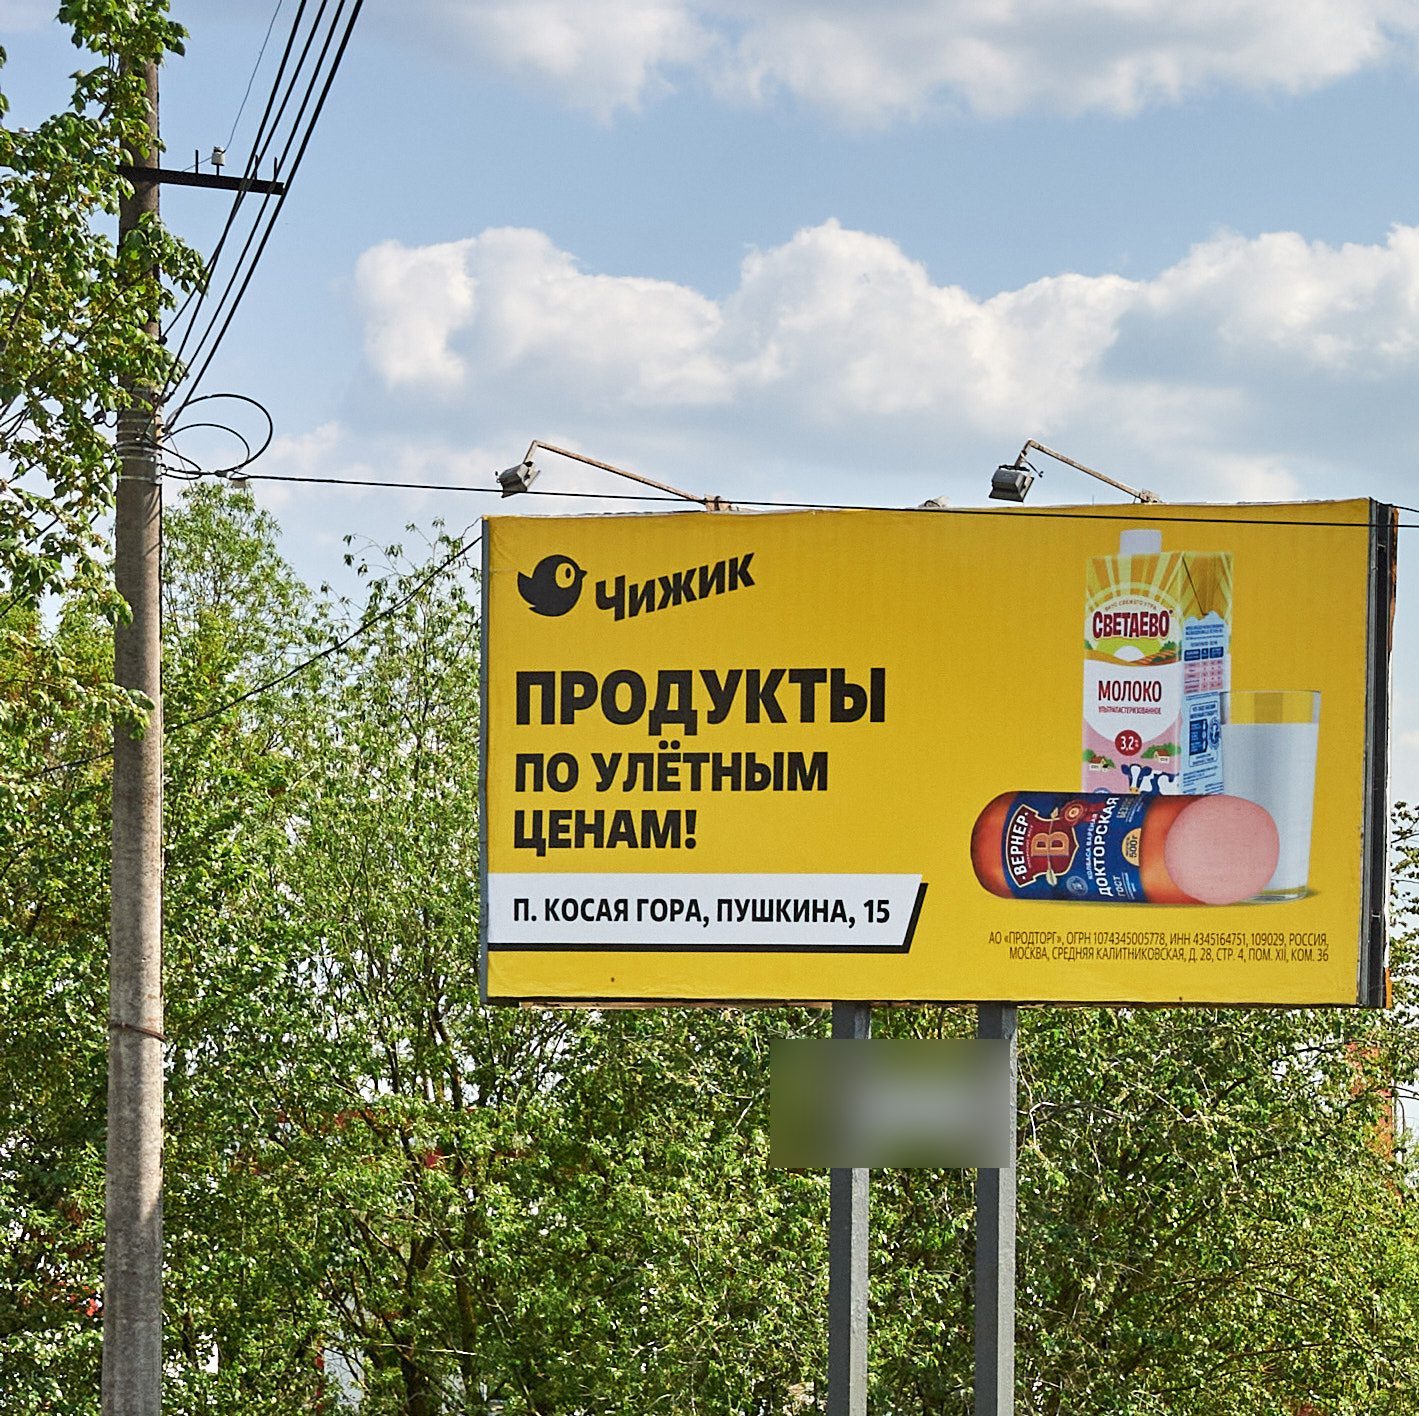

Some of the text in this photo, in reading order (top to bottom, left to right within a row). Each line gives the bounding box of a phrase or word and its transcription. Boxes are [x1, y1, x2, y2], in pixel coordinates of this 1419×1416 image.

[1092, 610, 1170, 639] СВЕТАЕВО
[516, 668, 886, 736] ПРОДУКТЫ
[1098, 680, 1162, 703] МОЛОКО
[515, 740, 829, 792] ПО УЛЁТНЫМ
[514, 810, 697, 857] ЦЕНАМ!
[1010, 814, 1029, 877] ВЕРНЕР
[1093, 797, 1120, 897] ДОКТОРСКАЯ
[513, 898, 890, 928] П. КОСАЯ ГОРА, ПУШКИНА, 15
[988, 932, 1002, 944] АО
[1066, 932, 1091, 945] ОГРН
[1169, 932, 1191, 945] ИНН
[1289, 933, 1329, 948] РОССИЯ,
[1009, 947, 1049, 961] МОСКВА,
[1052, 947, 1094, 961] СРЕДНЯЯ
[1248, 948, 1273, 961] ПОМ.
[1291, 948, 1315, 962] КОМ.
[1317, 948, 1329, 961] 36
